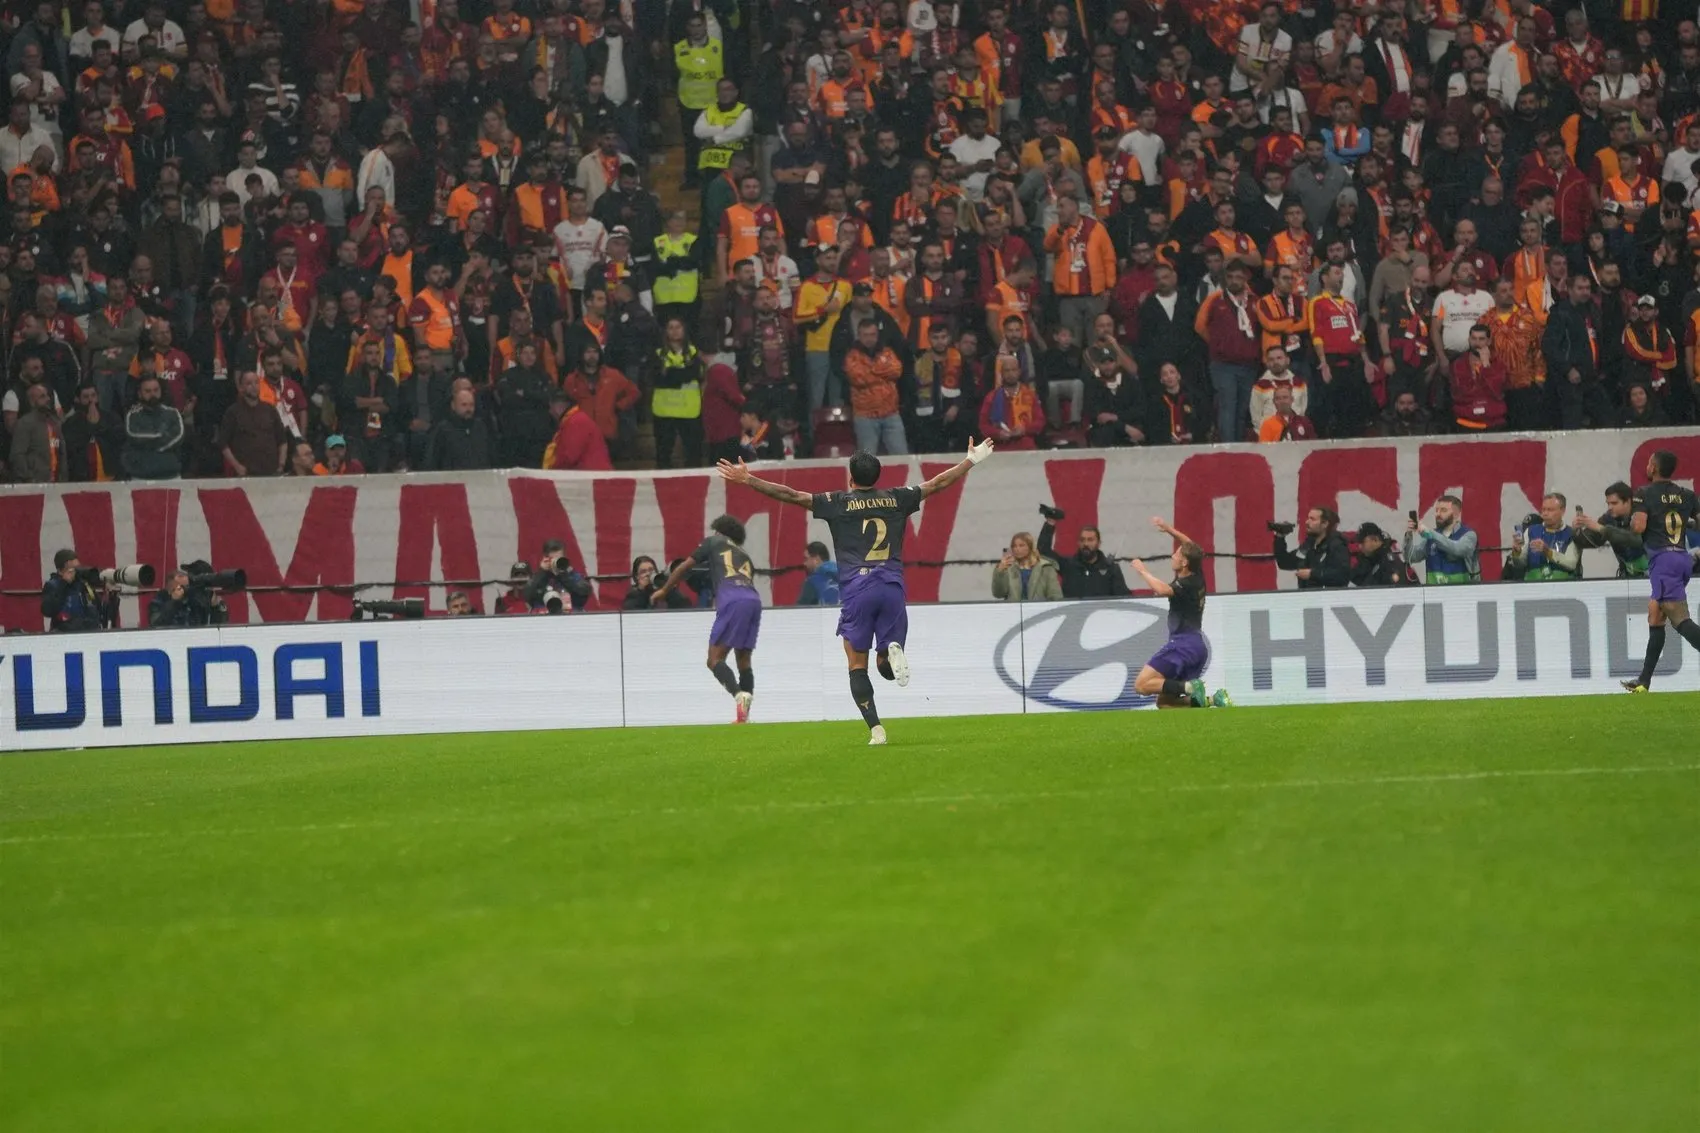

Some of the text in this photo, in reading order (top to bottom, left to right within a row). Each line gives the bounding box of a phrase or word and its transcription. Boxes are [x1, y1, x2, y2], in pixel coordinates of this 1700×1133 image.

[0, 461, 968, 632] UMANITY
[862, 517, 891, 562] 2
[1665, 510, 1683, 545] 9
[719, 549, 753, 579] 14
[1250, 597, 1700, 690] HYUND
[0, 640, 381, 732] UNDAI
